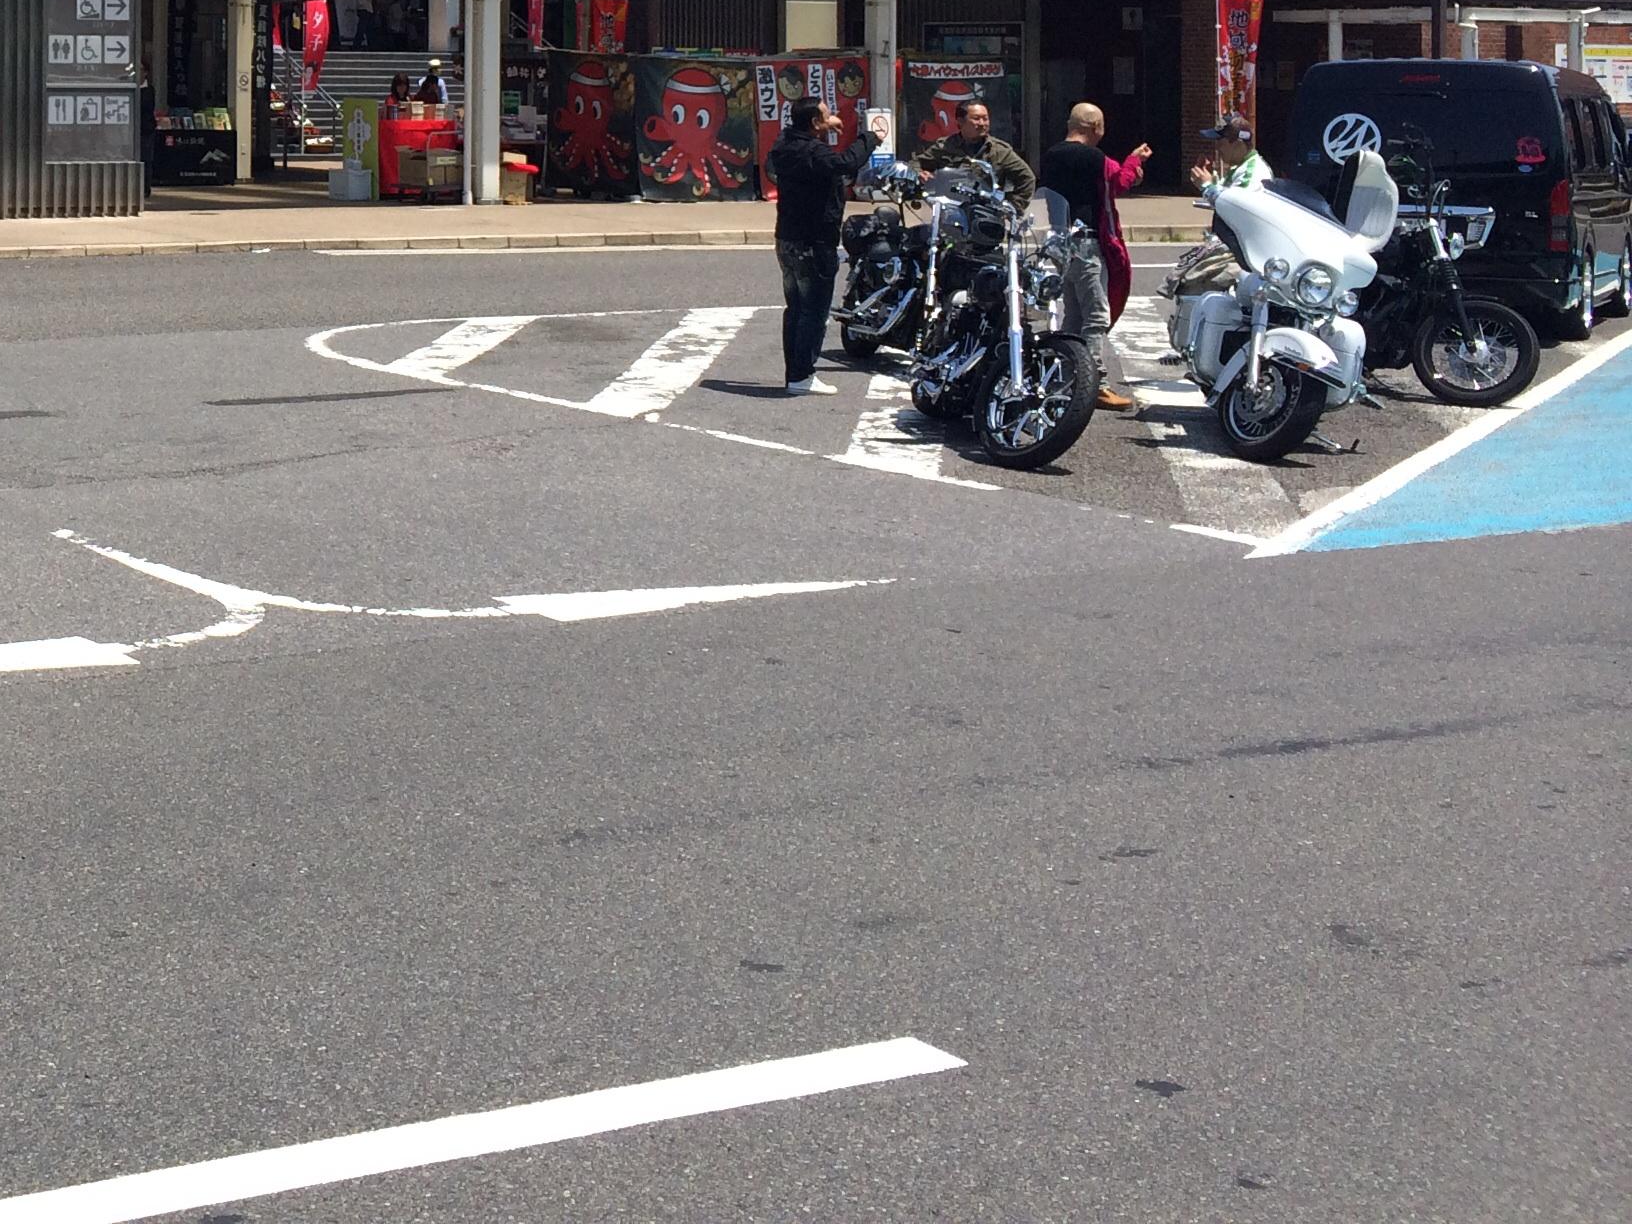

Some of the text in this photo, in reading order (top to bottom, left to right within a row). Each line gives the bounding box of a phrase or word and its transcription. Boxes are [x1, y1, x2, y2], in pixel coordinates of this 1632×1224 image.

[757, 66, 777, 119] 激ウマ
[810, 66, 822, 98] とろ
